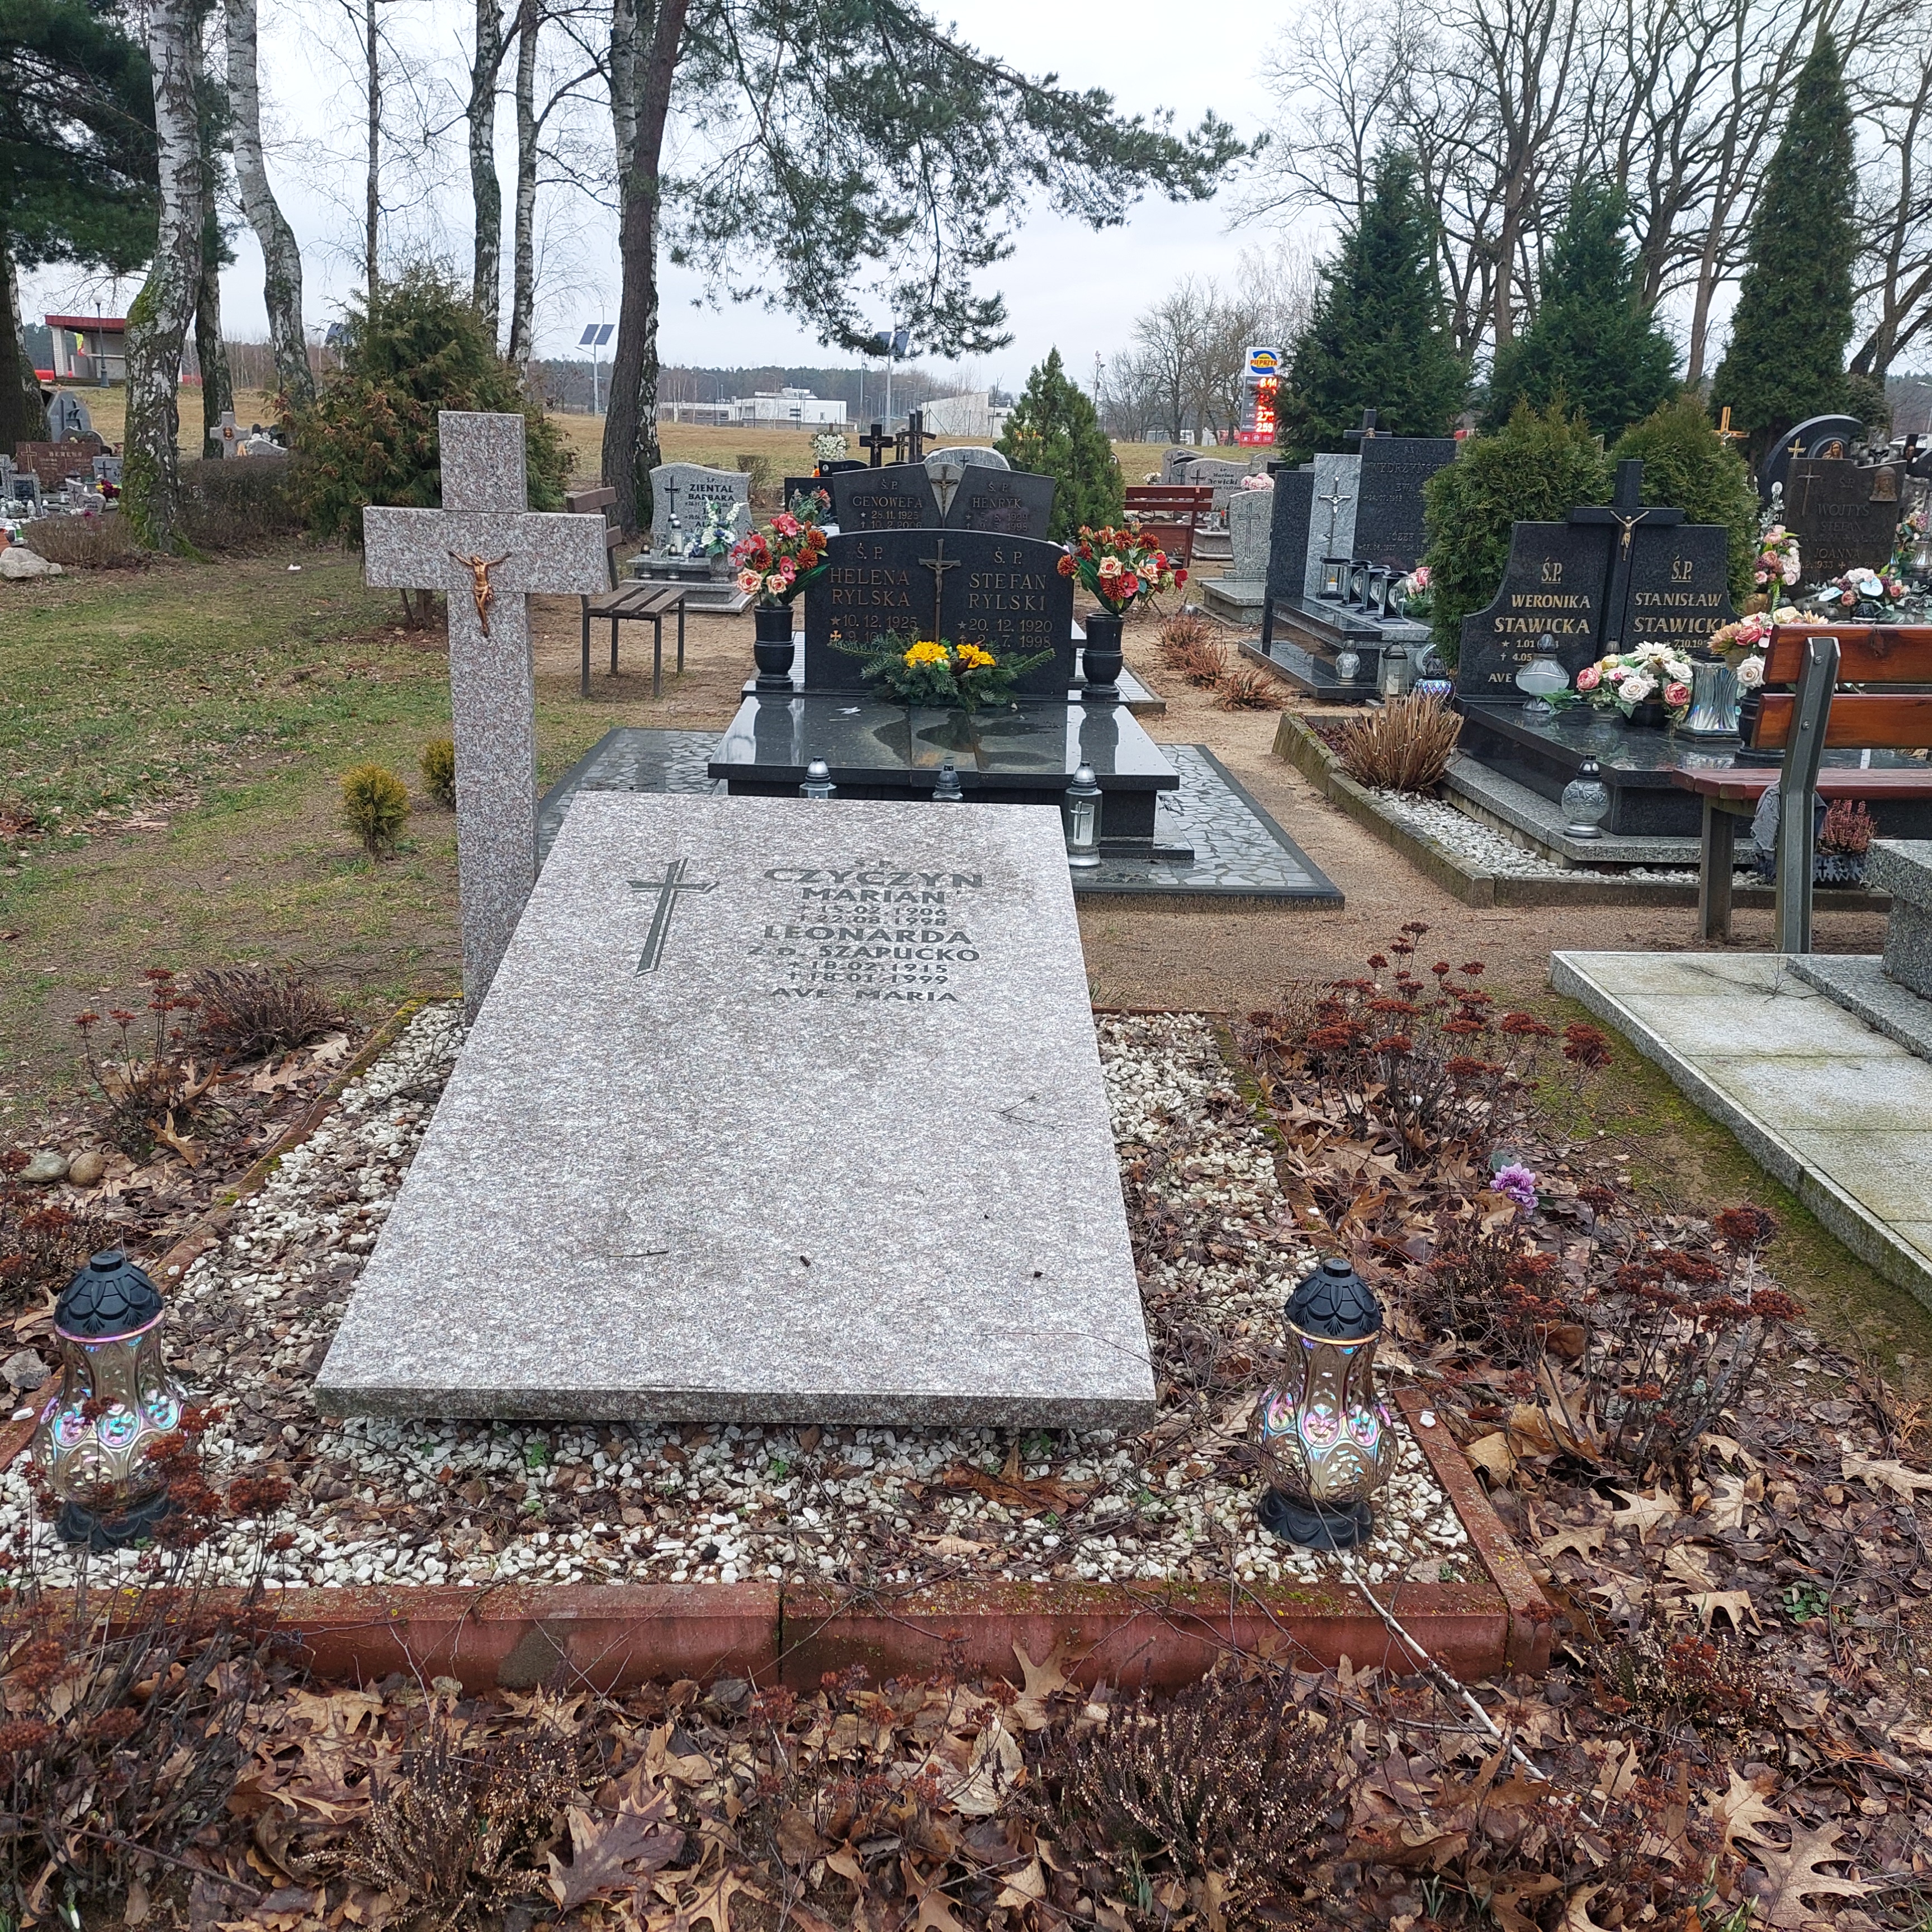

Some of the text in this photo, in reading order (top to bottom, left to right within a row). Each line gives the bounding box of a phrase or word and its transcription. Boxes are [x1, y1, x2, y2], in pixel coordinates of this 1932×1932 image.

[689, 484, 734, 493] ZIENTAL
[688, 493, 735, 501] BARBARA
[853, 496, 923, 508] GENOWEFA
[972, 497, 1022, 509] HENRYK
[1821, 521, 1861, 532] STEFAN
[1813, 548, 1861, 558] JOANNA
[830, 567, 910, 586] HELENA
[969, 572, 1047, 590] STEFAN
[832, 589, 911, 607] RYLSKA
[969, 593, 1045, 611] RYLSKI
[1512, 594, 1591, 609] WERONIKA
[1635, 592, 1722, 607] STANISŁAW
[842, 614, 918, 629] 10. 12. 1925
[969, 618, 1053, 632] 20. 12. 1920
[1494, 617, 1591, 634] STAWICKA
[1633, 617, 1727, 633] STAWICKI
[1020, 635, 1052, 648] 1998
[1488, 673, 1512, 683] AVE
[764, 868, 983, 888] CZYCZYN
[801, 887, 945, 904] MARIAN
[821, 905, 948, 917] 15.02.1906
[764, 925, 973, 945] LEONARDA
[819, 944, 981, 962] SZAPUĆKO
[812, 960, 948, 974] 18.02.1915
[810, 972, 949, 985] 18.01.1999
[770, 988, 960, 1002] AVE MARIA
